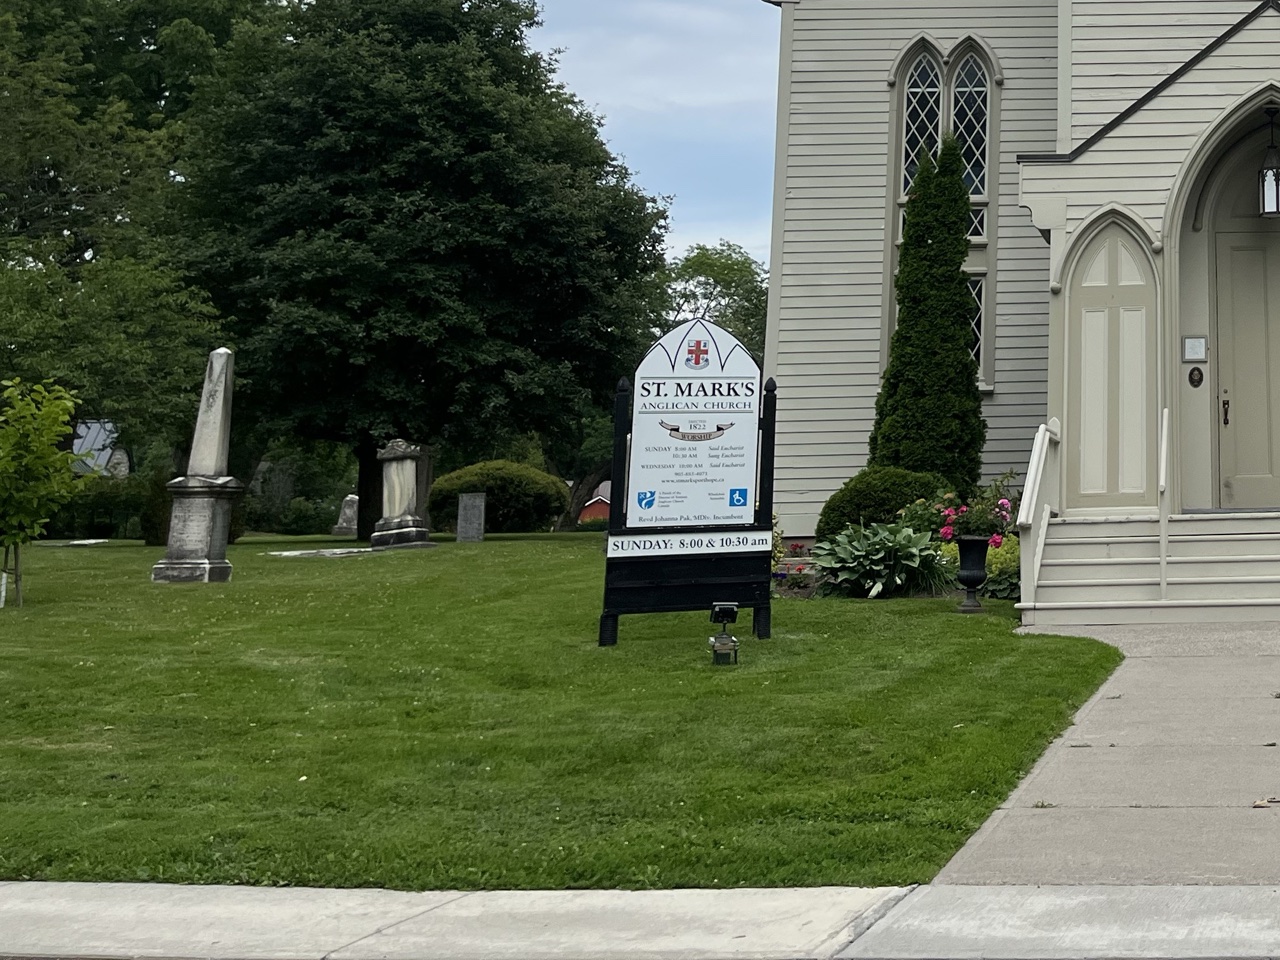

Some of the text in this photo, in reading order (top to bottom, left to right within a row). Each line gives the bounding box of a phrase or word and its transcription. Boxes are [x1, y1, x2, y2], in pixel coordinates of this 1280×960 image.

[640, 381, 755, 397] ST. MARK'S
[640, 401, 751, 410] ANGLICAN CHURCH
[681, 432, 712, 441] WORSHIP
[612, 536, 768, 551] SUNDAY: 8:00 & 10:30 am
